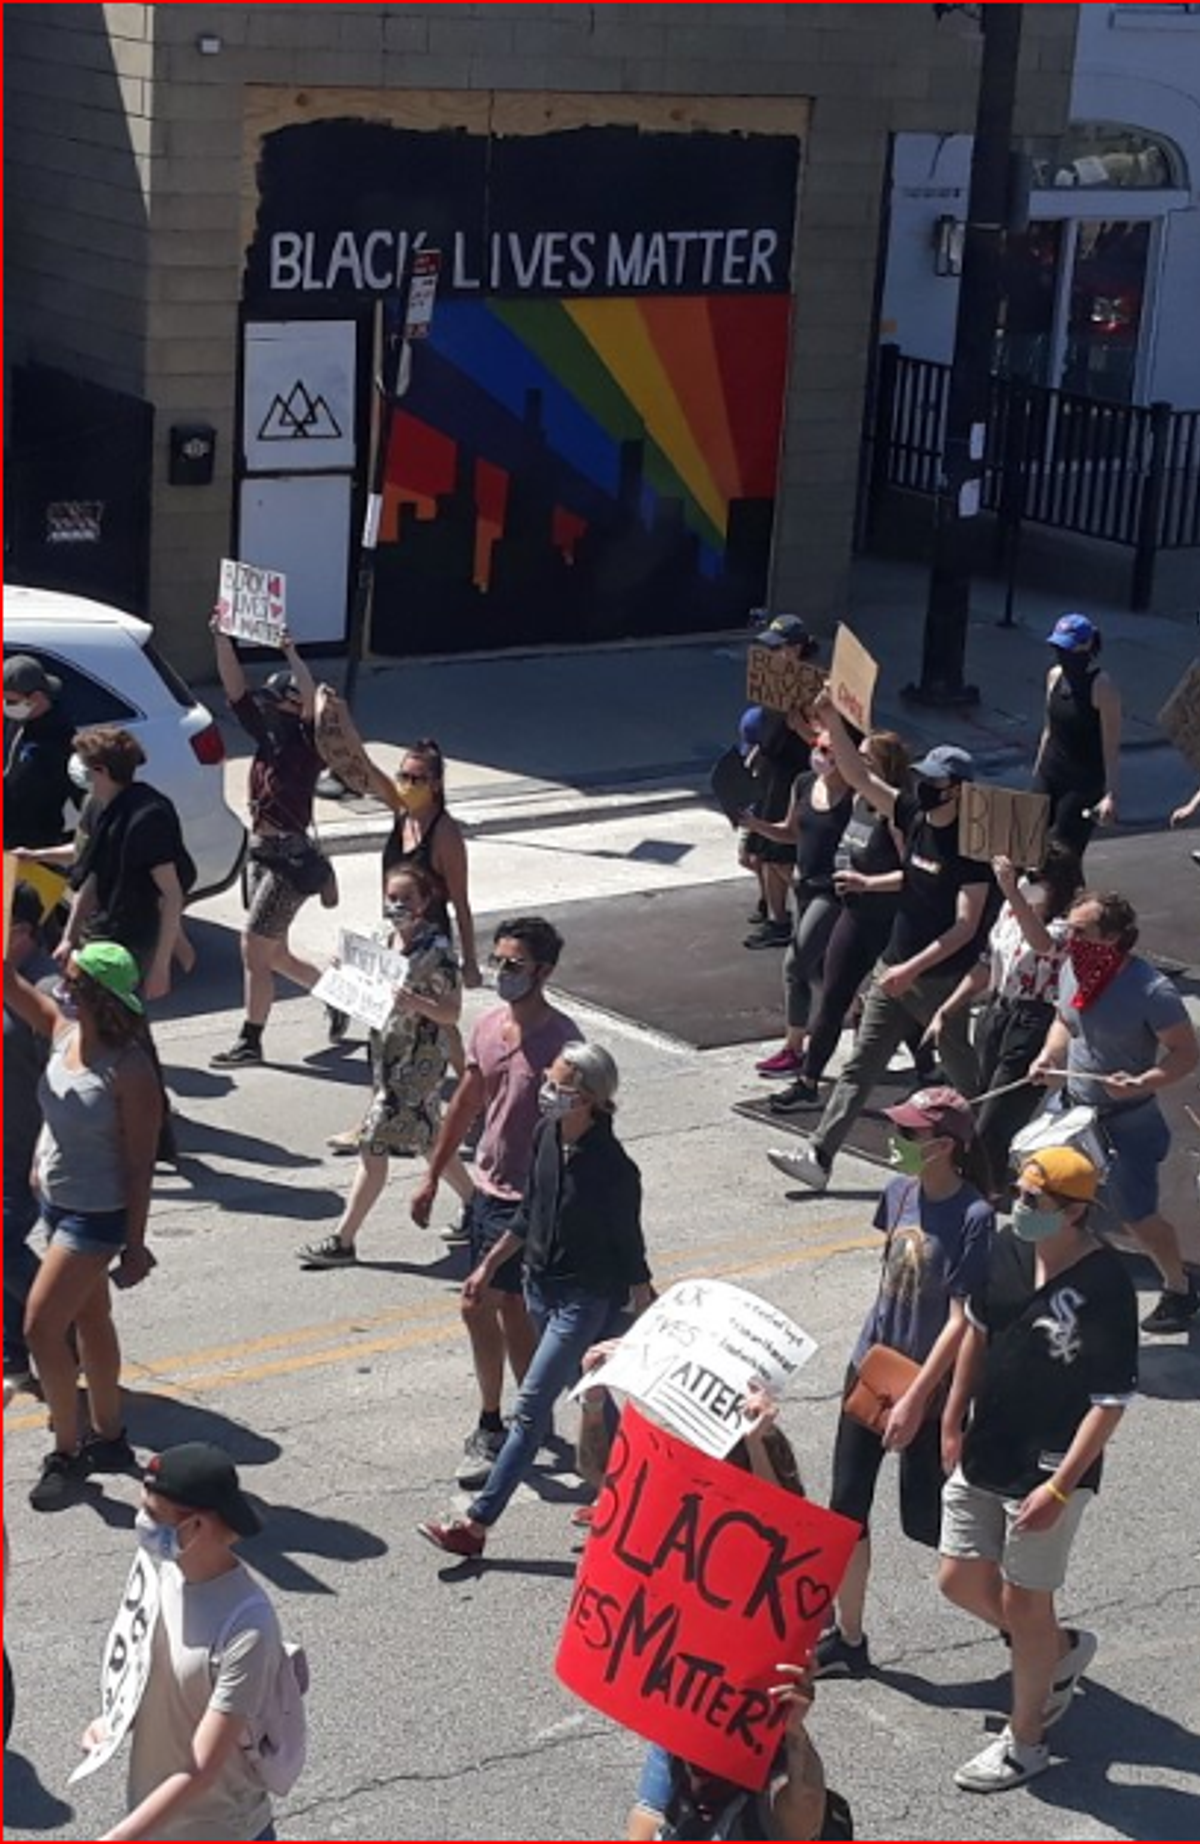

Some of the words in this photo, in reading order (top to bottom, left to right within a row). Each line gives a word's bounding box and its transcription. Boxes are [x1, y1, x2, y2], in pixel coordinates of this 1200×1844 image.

[270, 230, 428, 290] BLACK
[453, 231, 596, 289] LIVES
[606, 228, 778, 287] MATTER
[965, 785, 1048, 868] BLM
